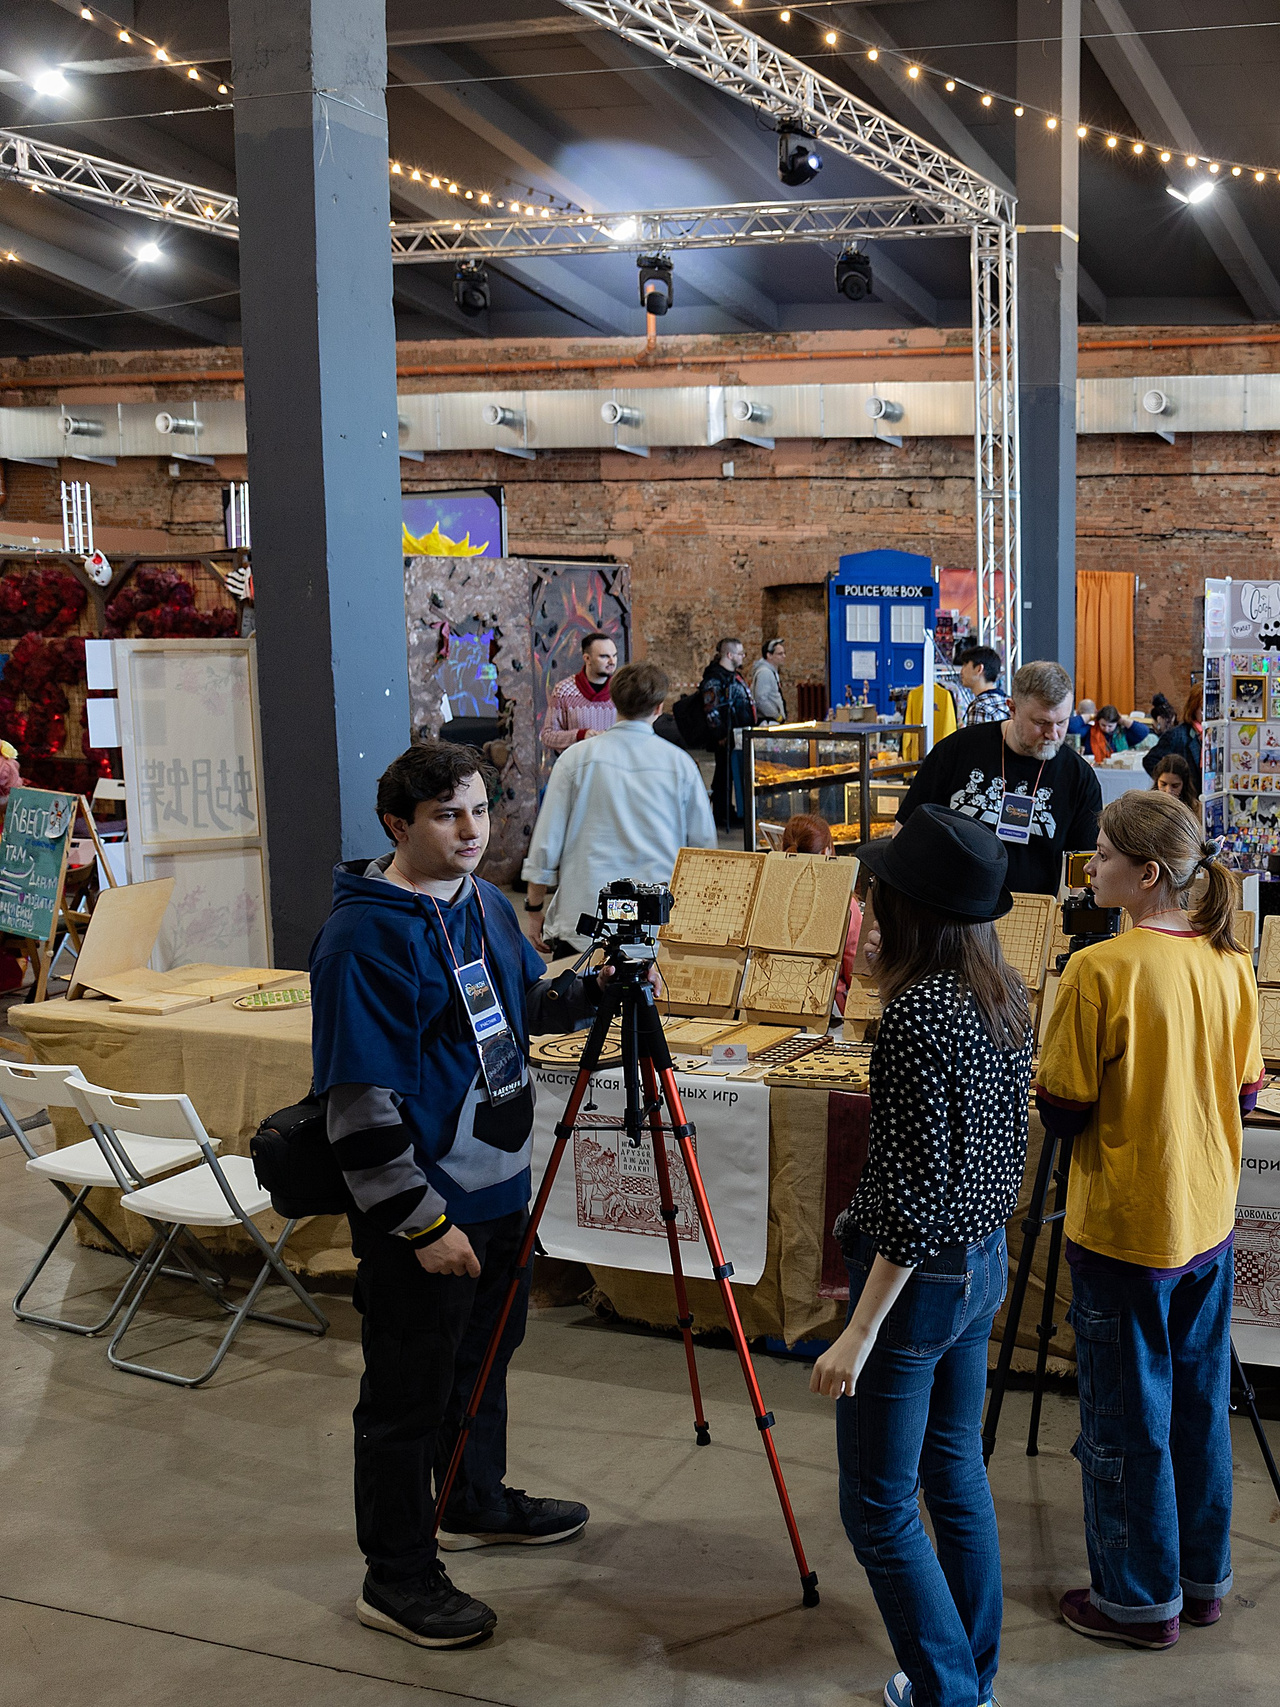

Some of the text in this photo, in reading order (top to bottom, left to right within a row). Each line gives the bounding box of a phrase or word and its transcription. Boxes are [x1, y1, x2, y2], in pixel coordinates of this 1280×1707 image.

[844, 585, 924, 597] POLICE BOX
[535, 1070, 620, 1091] мастеская
[711, 1089, 740, 1107] игр
